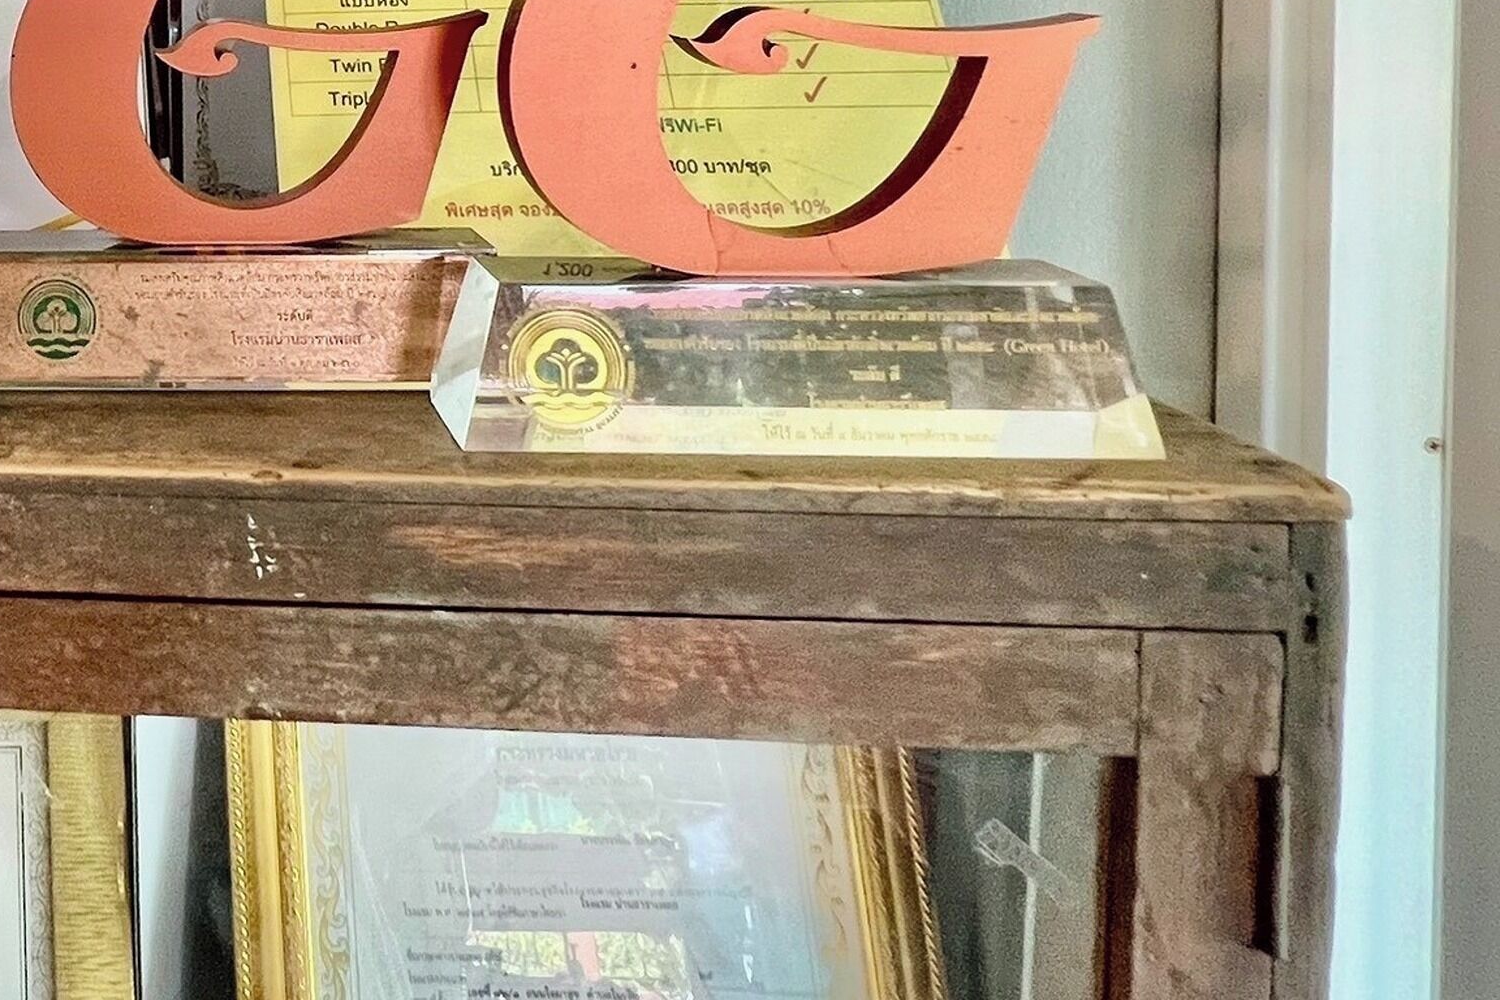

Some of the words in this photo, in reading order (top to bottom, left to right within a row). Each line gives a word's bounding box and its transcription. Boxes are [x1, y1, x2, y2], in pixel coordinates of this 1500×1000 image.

[329, 58, 372, 73] Twin
[328, 90, 369, 109] Tripl
[704, 159, 772, 177] บาท/ชุด
[445, 202, 514, 221] พิเศษสุด
[791, 198, 831, 215] 10%
